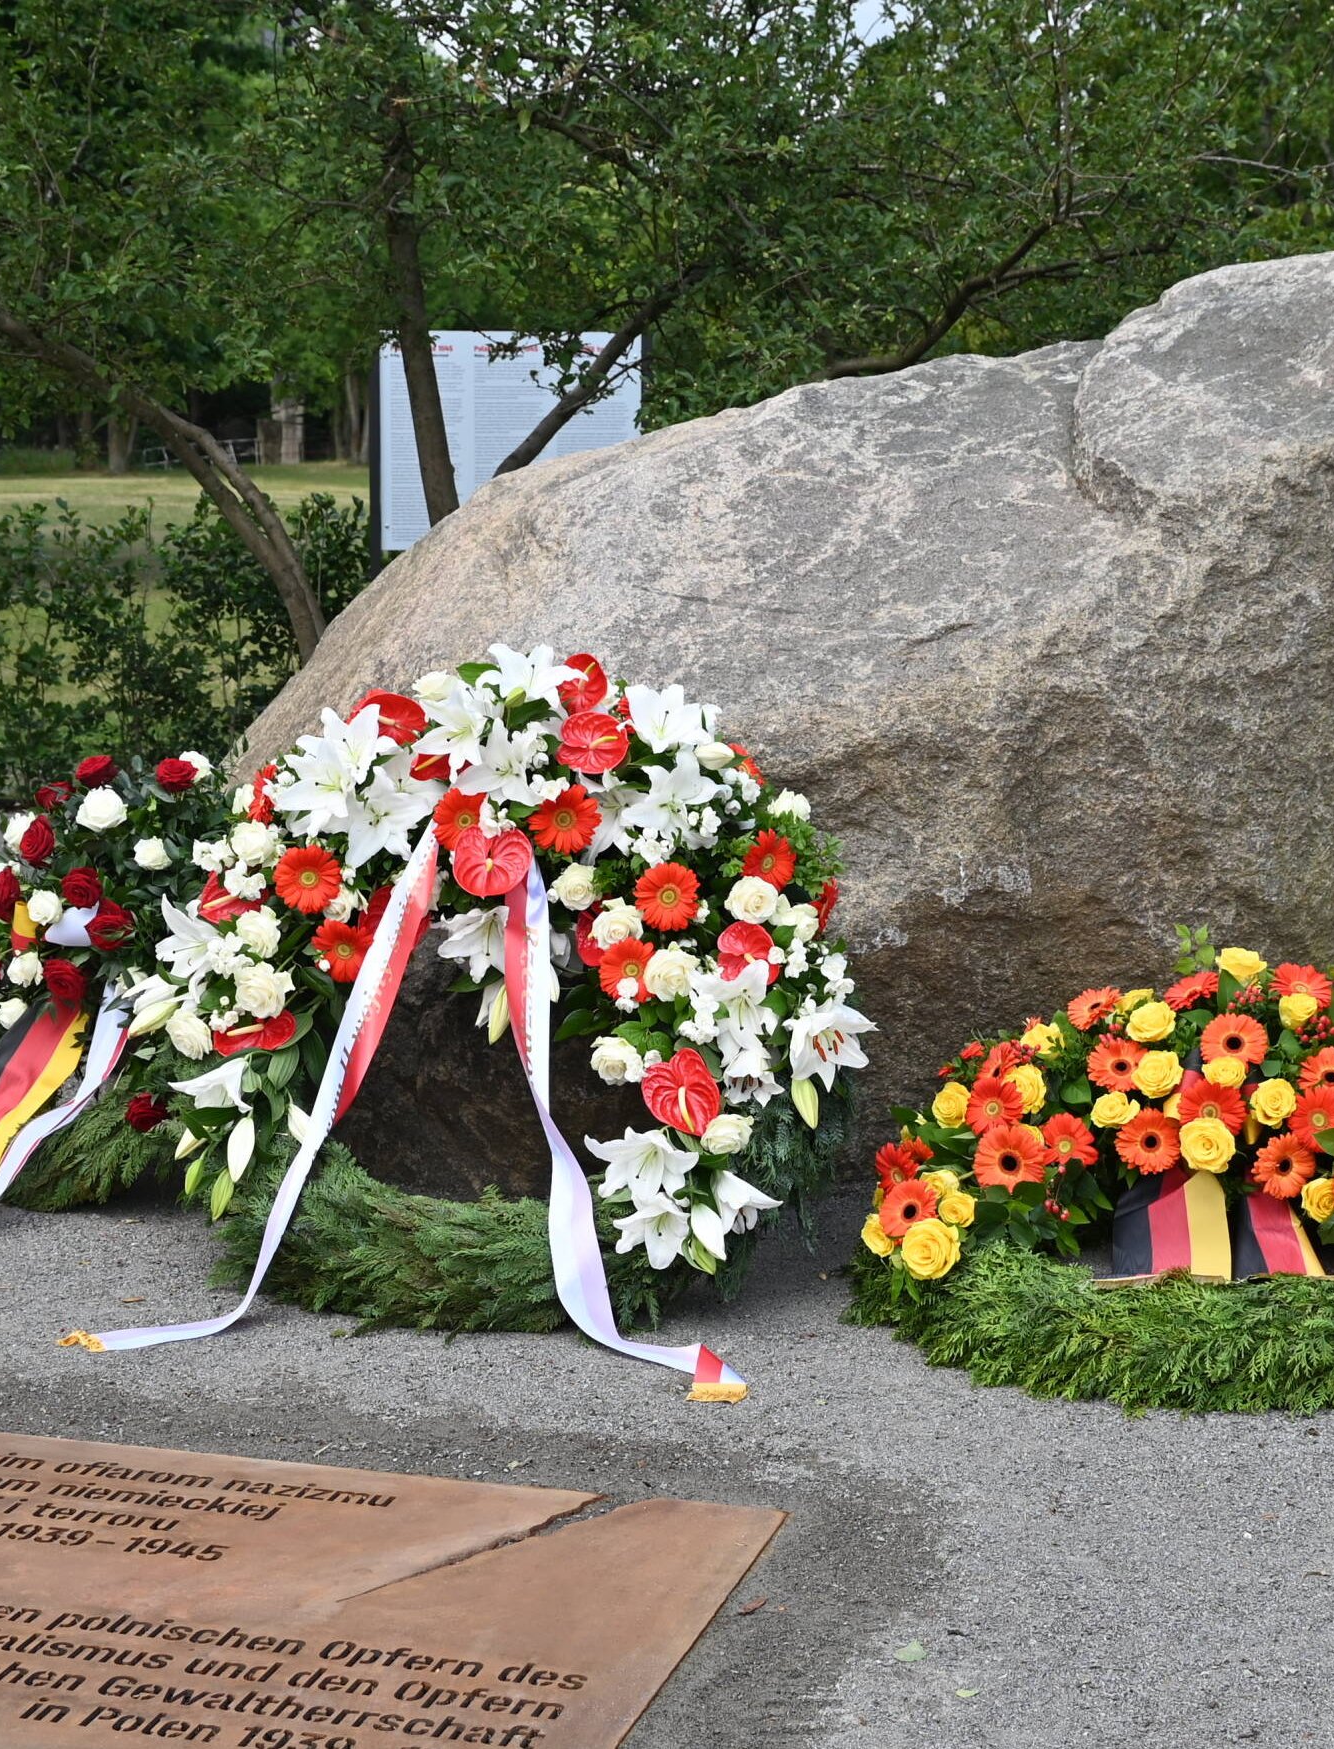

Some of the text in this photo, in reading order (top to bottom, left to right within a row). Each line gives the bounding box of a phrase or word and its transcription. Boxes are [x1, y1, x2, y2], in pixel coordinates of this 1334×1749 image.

[47, 1482, 288, 1521] niemieckiej
[53, 1461, 215, 1488] ofiarom
[220, 1478, 397, 1508] nazizmu
[3, 1498, 29, 1515] i
[32, 1502, 180, 1532] terroru
[43, 1612, 307, 1656] polnischen
[318, 1639, 484, 1678] Opfern
[497, 1662, 588, 1691] des
[97, 1675, 546, 1749] Gewaltherrschaft
[183, 1657, 284, 1683] und
[287, 1667, 380, 1697] den
[393, 1680, 565, 1720] Opfern
[19, 1696, 71, 1724] in
[78, 1704, 222, 1744] Polen
